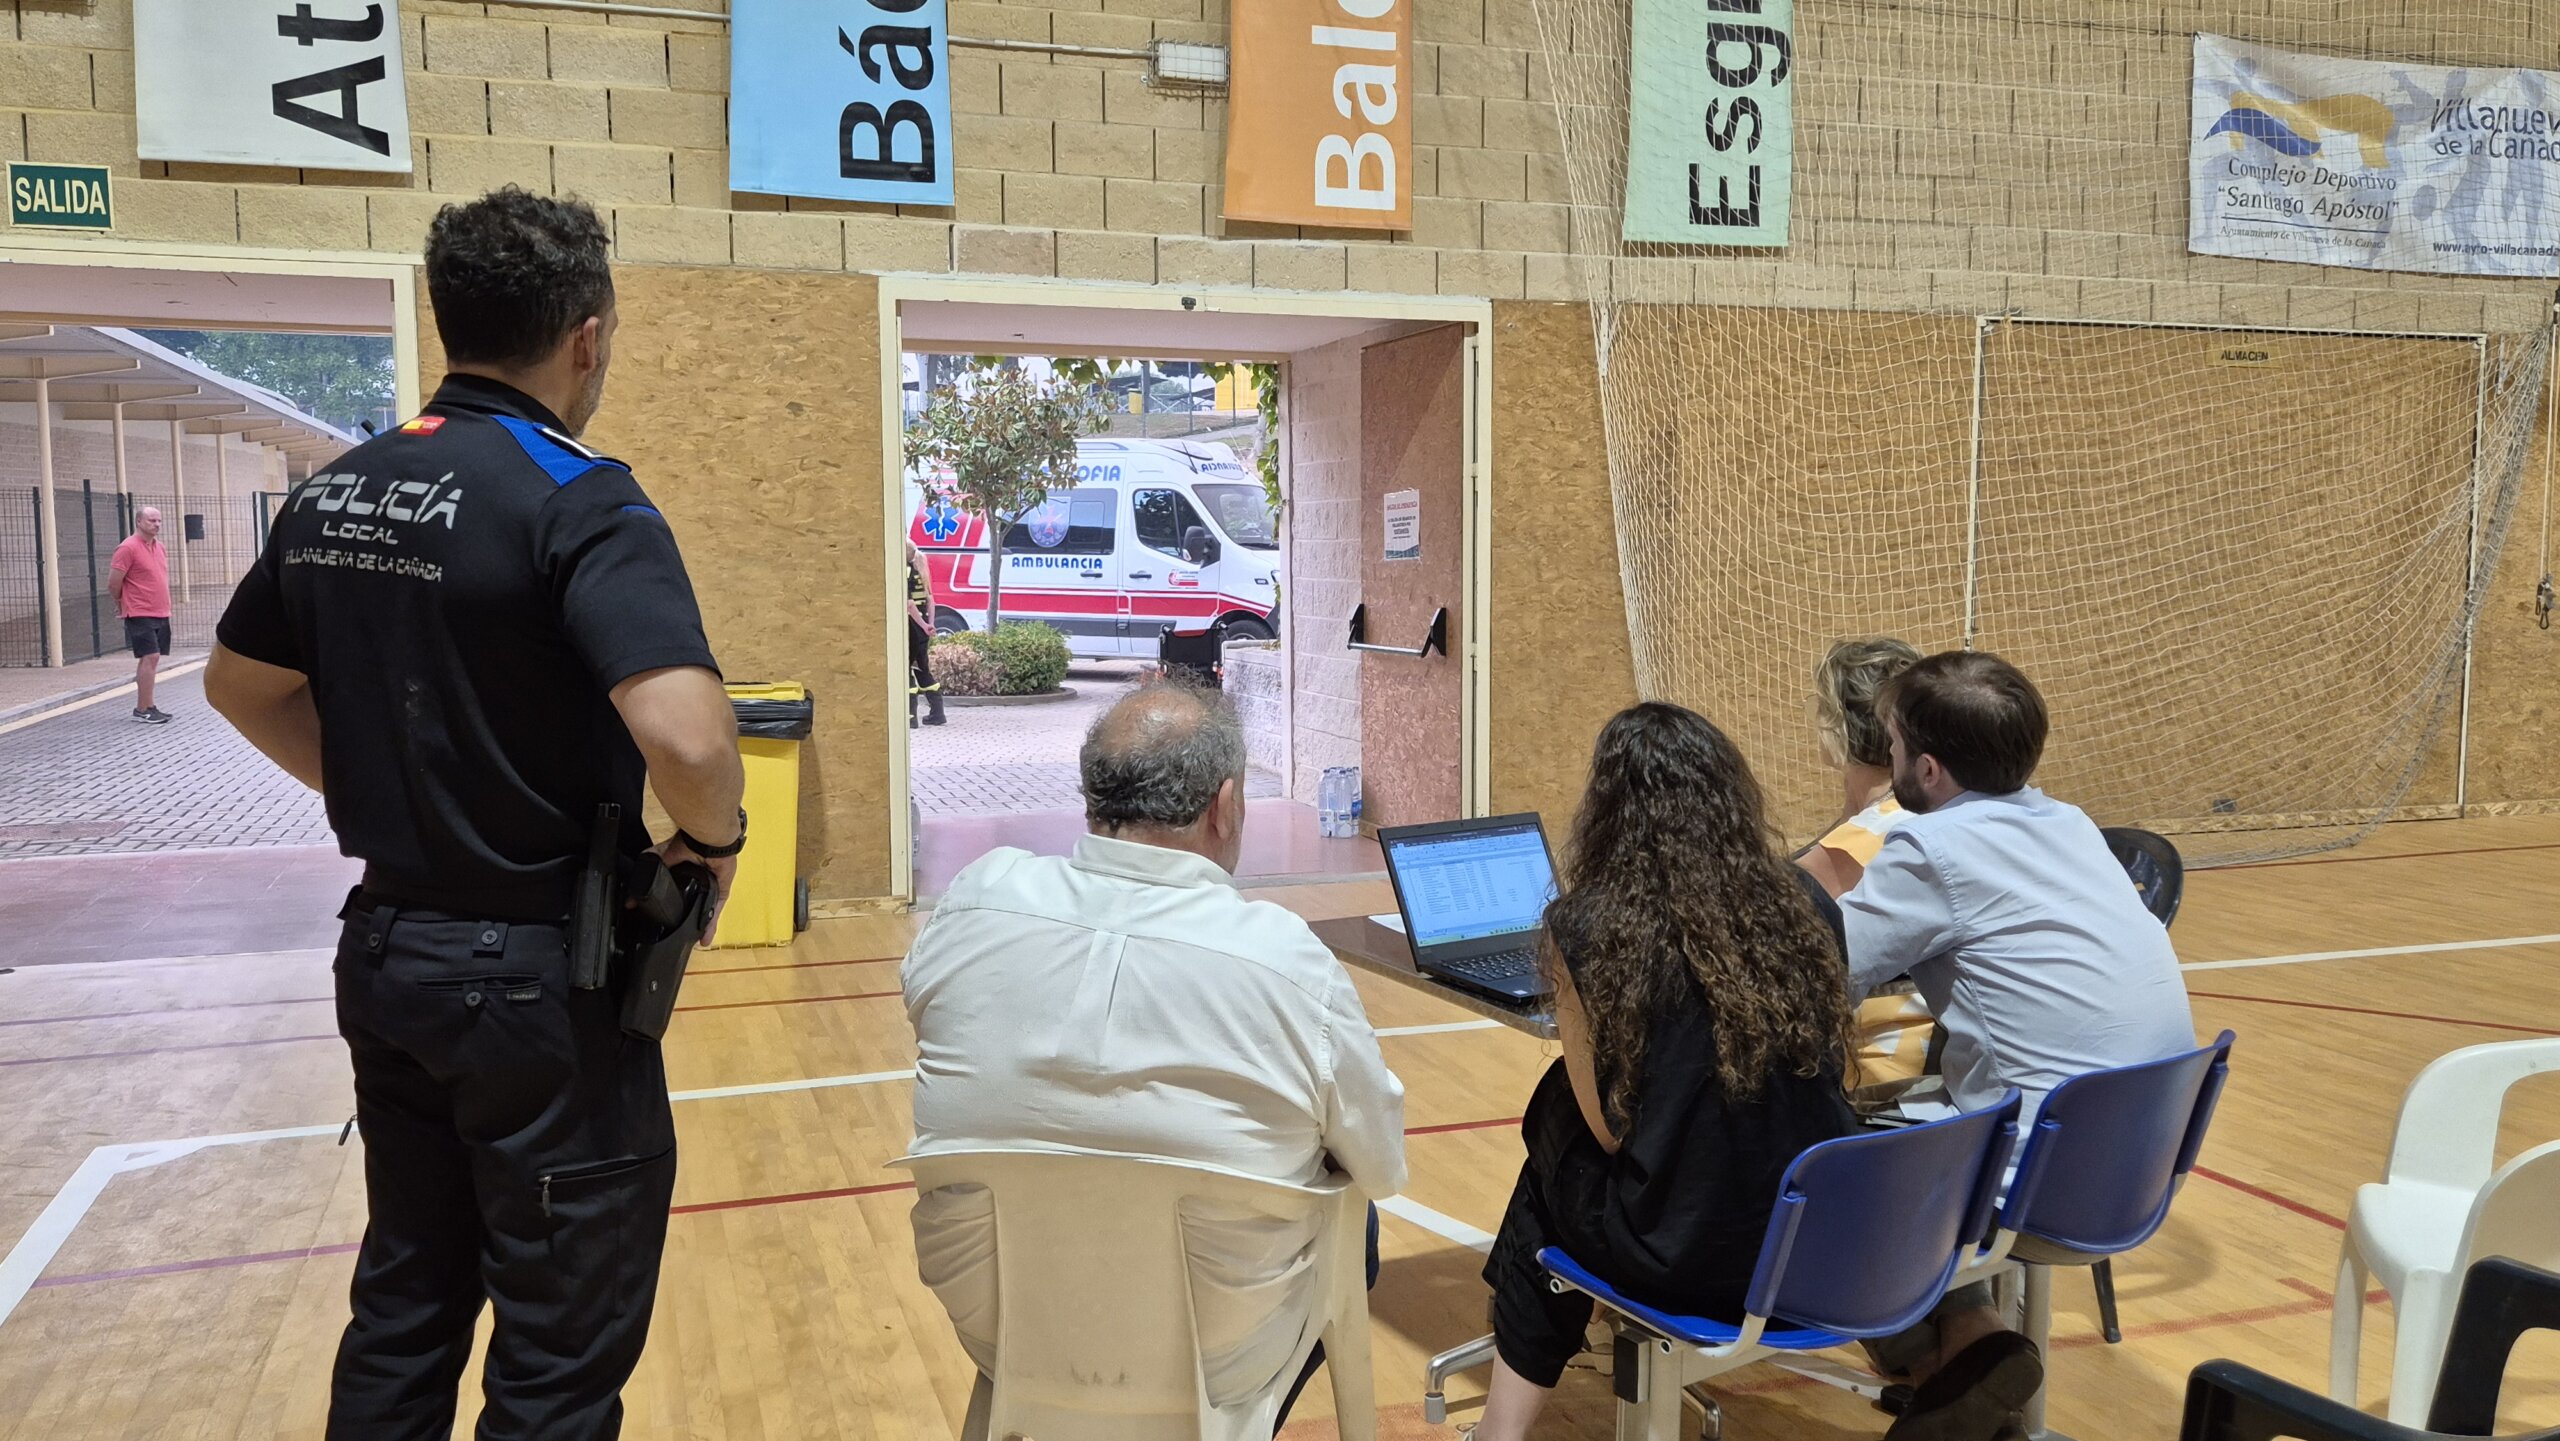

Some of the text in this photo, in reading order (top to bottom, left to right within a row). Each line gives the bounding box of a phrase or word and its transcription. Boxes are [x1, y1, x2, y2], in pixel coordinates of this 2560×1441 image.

[838, 0, 936, 183] Bá
[1311, 0, 1398, 210] Bal
[2434, 136, 2463, 155] de
[2468, 133, 2483, 156] la
[2228, 156, 2397, 192] Complejo Deportivo
[15, 176, 107, 216] SALIDA
[1059, 465, 1121, 481] OFIA
[293, 471, 463, 529] POLICÍA
[321, 521, 399, 545] LOCAL
[356, 552, 377, 571] DE
[378, 555, 394, 572] LA
[396, 556, 443, 583] CAÑADA
[1012, 557, 1103, 569] AMBULANCIA
